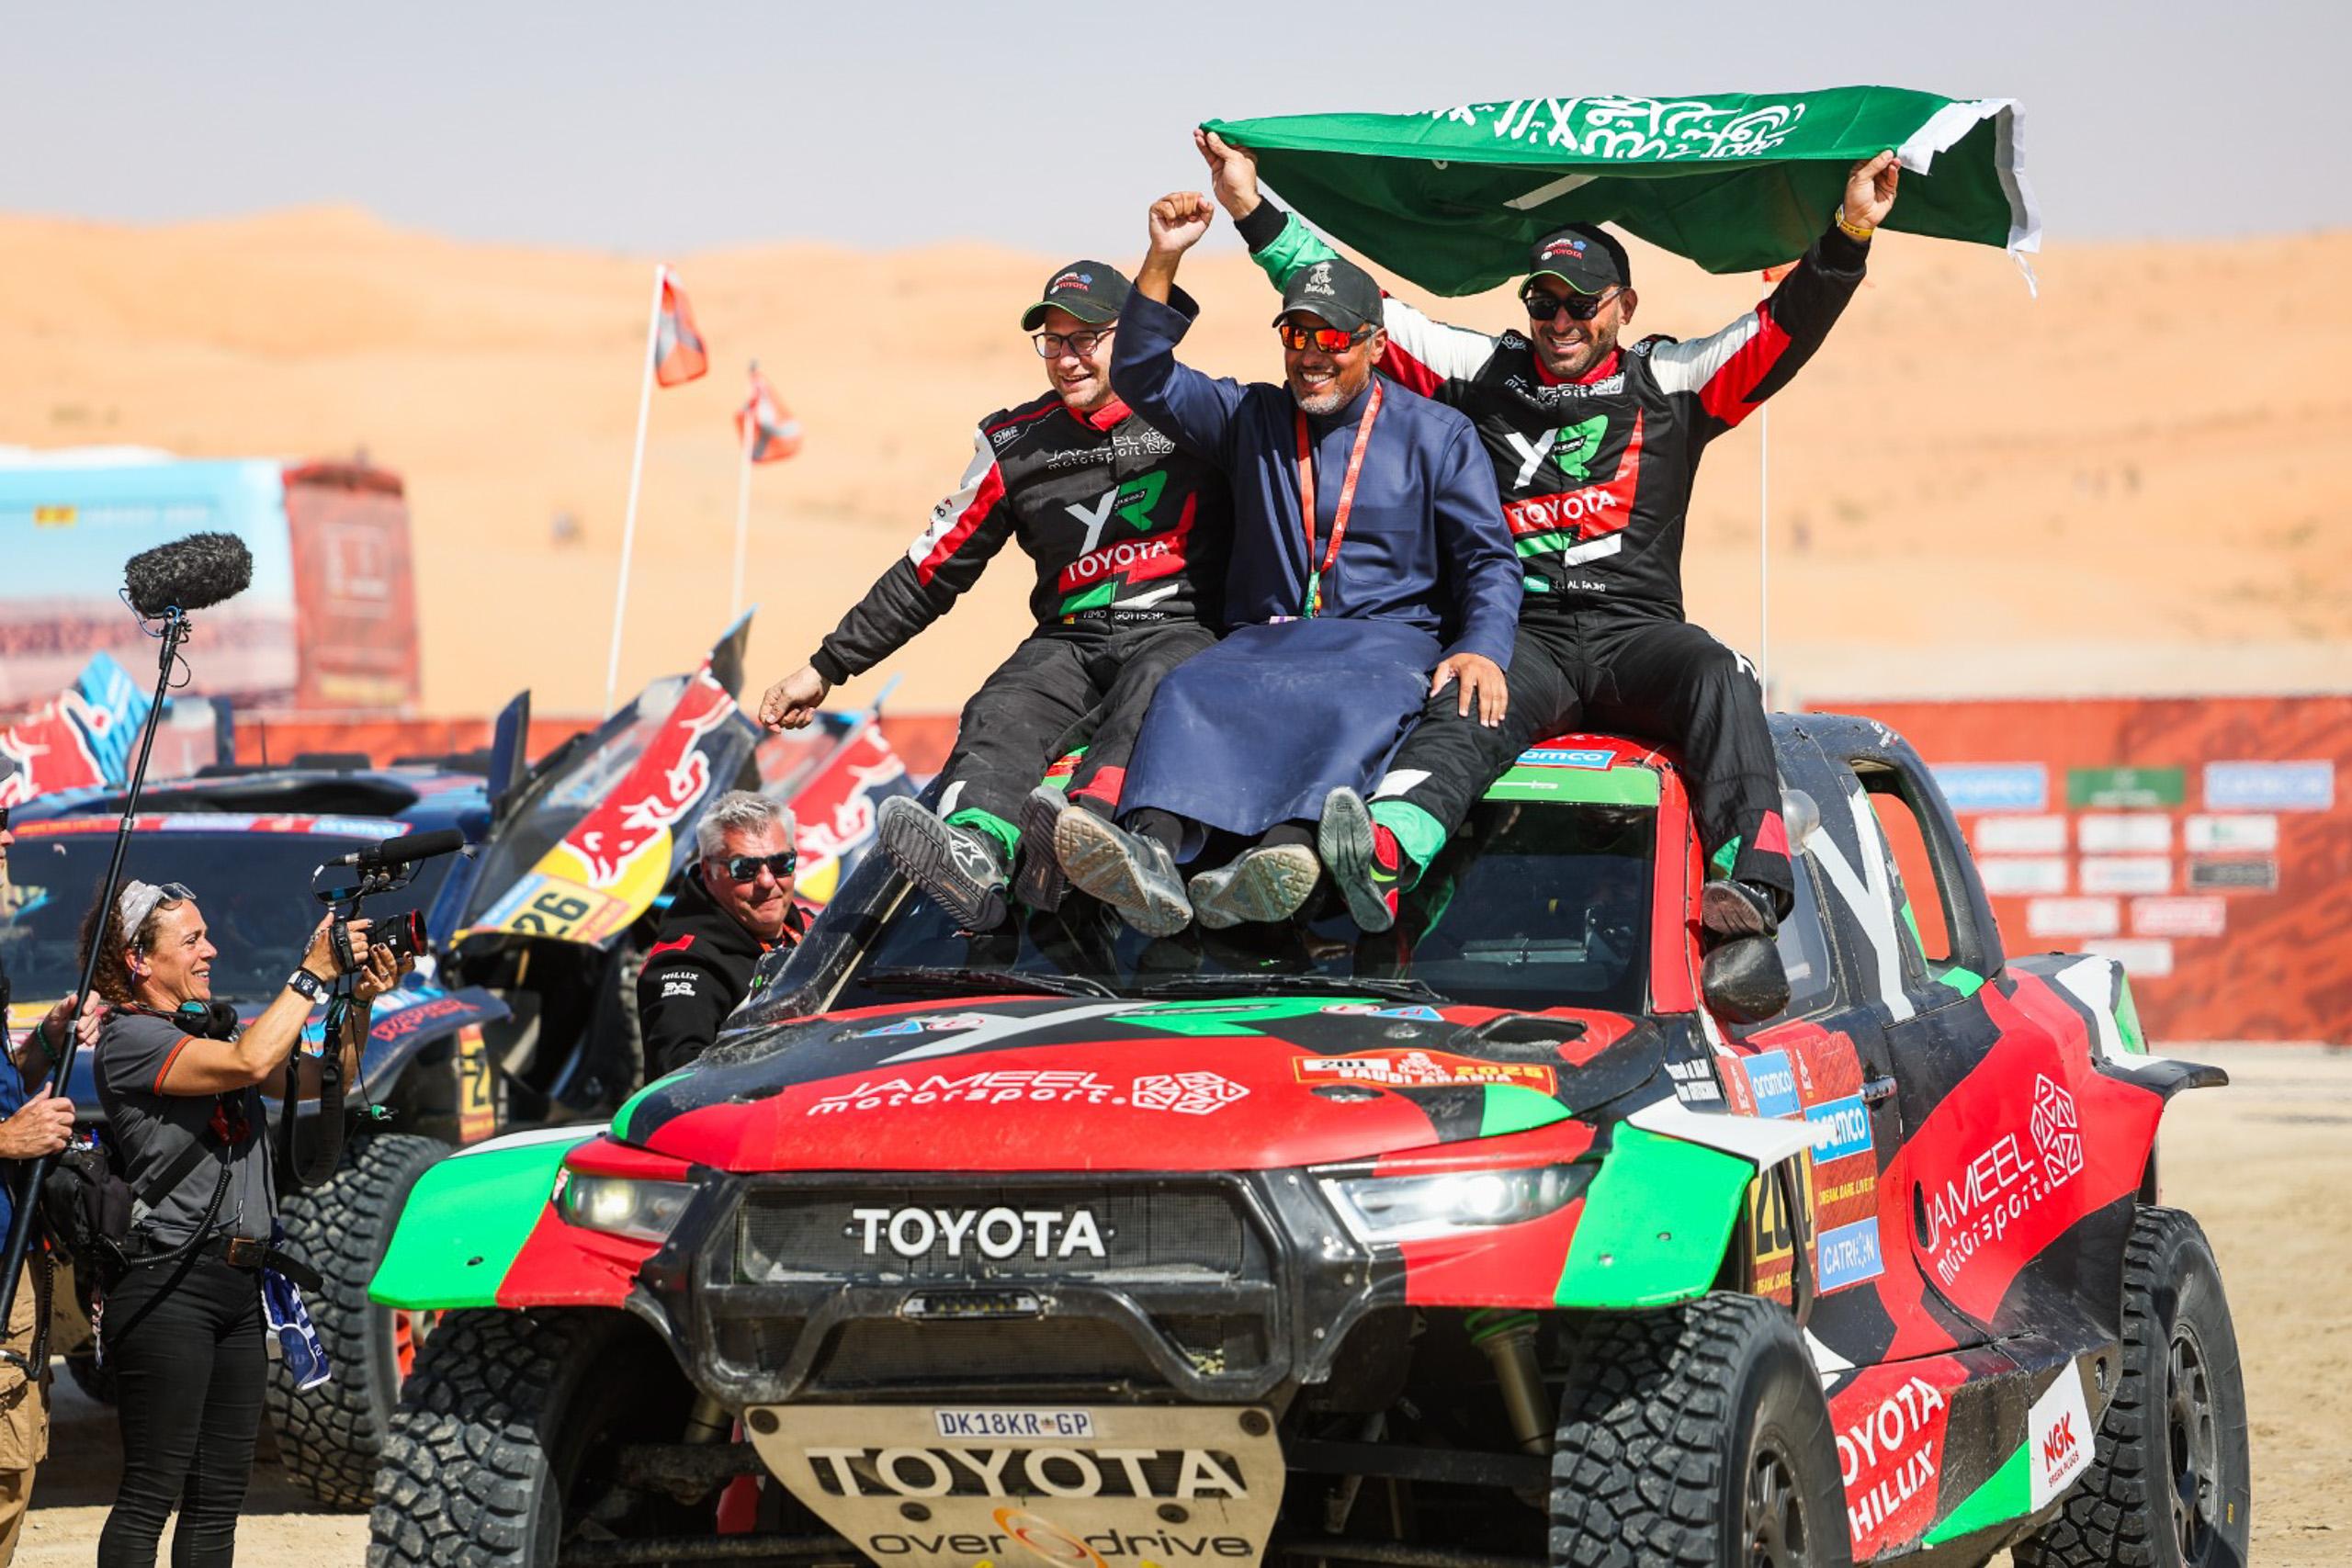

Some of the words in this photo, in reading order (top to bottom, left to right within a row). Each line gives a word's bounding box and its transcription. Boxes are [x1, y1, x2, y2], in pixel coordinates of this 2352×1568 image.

[1552, 248, 1583, 260] TOYOTA
[1058, 281, 1090, 292] TOYOTA
[1513, 490, 1617, 526] TOYOTA
[1066, 539, 1170, 581] TOYOTA
[661, 971, 699, 981] HILUX
[1319, 1059, 1368, 1068] 201
[1337, 1067, 1413, 1085] SAUDI
[1421, 1074, 1514, 1085] ARABIA
[1454, 1065, 1544, 1078] 2025
[820, 1069, 1114, 1102] JAMEEL
[1751, 1070, 1792, 1100] aramco
[1927, 1133, 2034, 1255] JAMEEL
[853, 1206, 1107, 1258] TOYOTA
[941, 1413, 1040, 1436] DK18KR
[1056, 1413, 1089, 1435] GP
[1835, 1376, 1945, 1488] OYOTA
[2041, 1411, 2077, 1472] NGK
[803, 1447, 1250, 1500] TOYOTA
[2047, 1463, 2065, 1488] SPARK
[1847, 1439, 1936, 1543] HILUX
[868, 1532, 1010, 1555] over
[1083, 1529, 1254, 1558] drive
